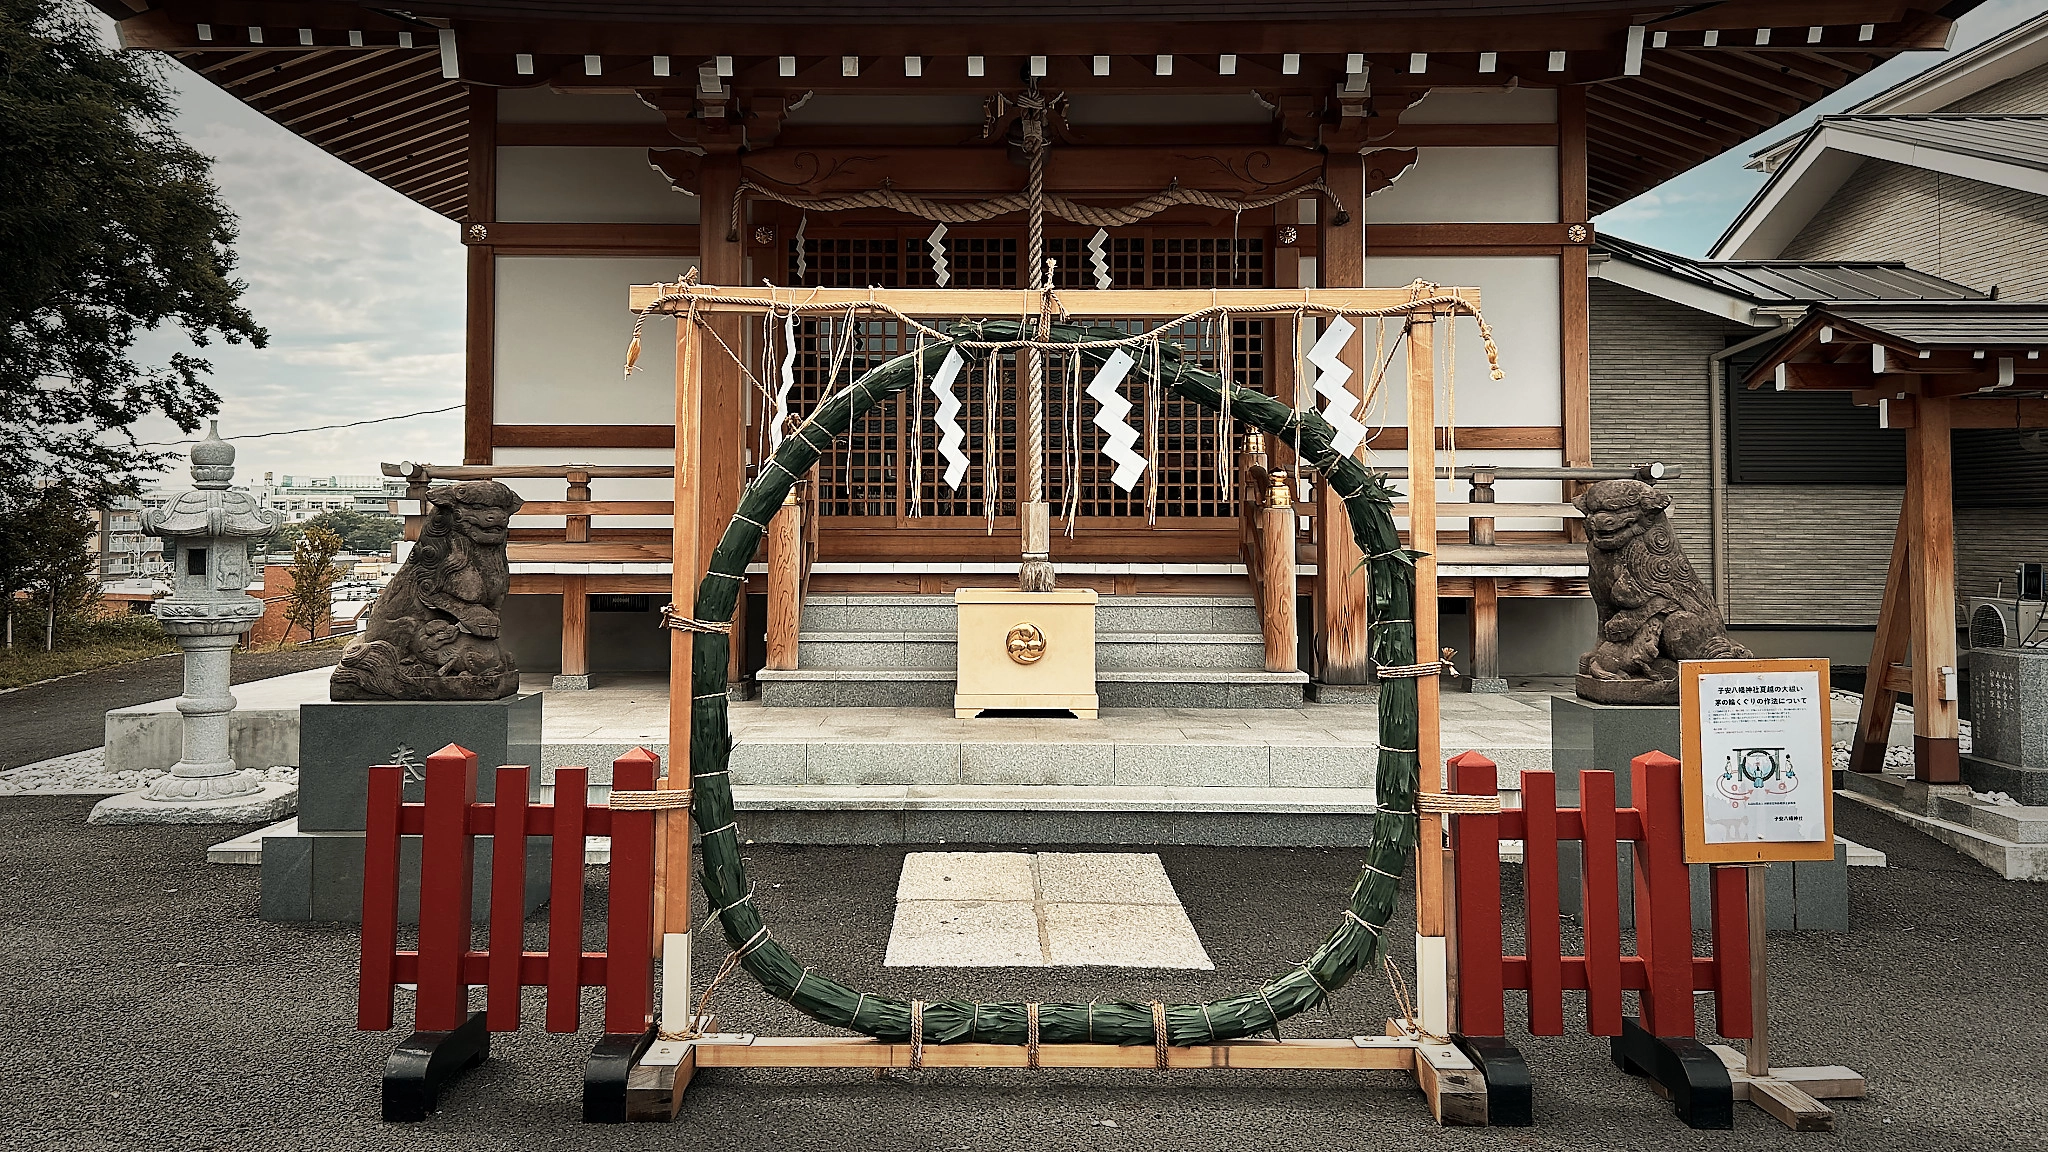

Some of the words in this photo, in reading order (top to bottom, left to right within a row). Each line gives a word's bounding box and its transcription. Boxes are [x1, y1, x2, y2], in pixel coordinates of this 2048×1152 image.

[1714, 697, 1807, 707] 茅の輪くぐりの作法について
